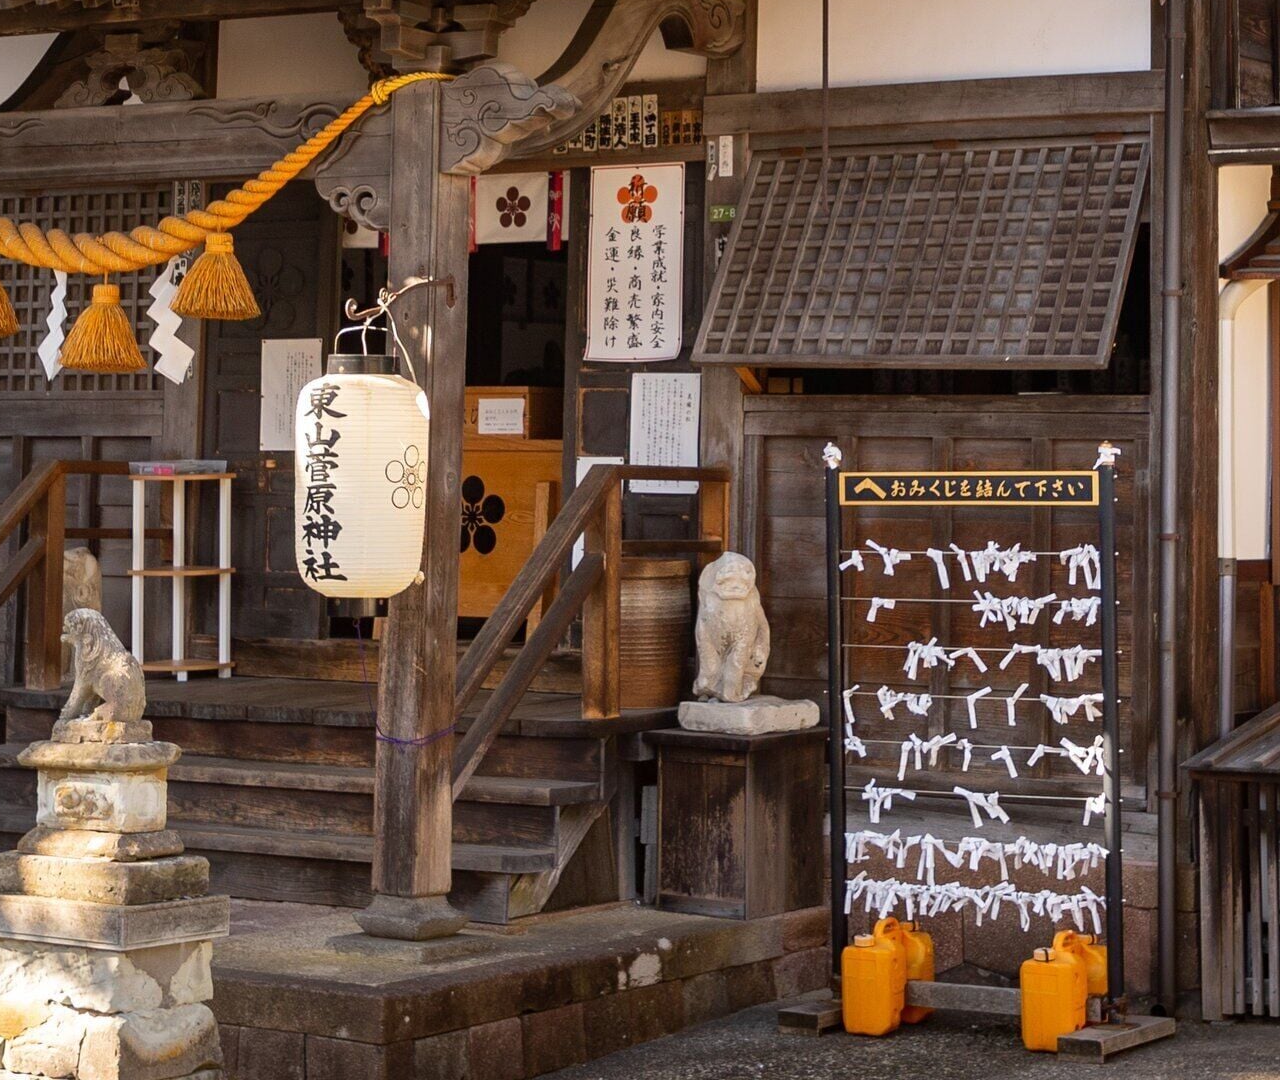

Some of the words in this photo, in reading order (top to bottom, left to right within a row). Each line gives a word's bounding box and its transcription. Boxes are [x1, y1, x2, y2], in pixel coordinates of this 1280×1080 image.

[627, 175, 649, 224] 祈願
[603, 226, 622, 348] 金運・災難除け
[625, 226, 645, 349] 良縁・商売繁盛
[649, 224, 668, 349] 学業成就・家内安全
[301, 382, 348, 582] 東山菅原神社
